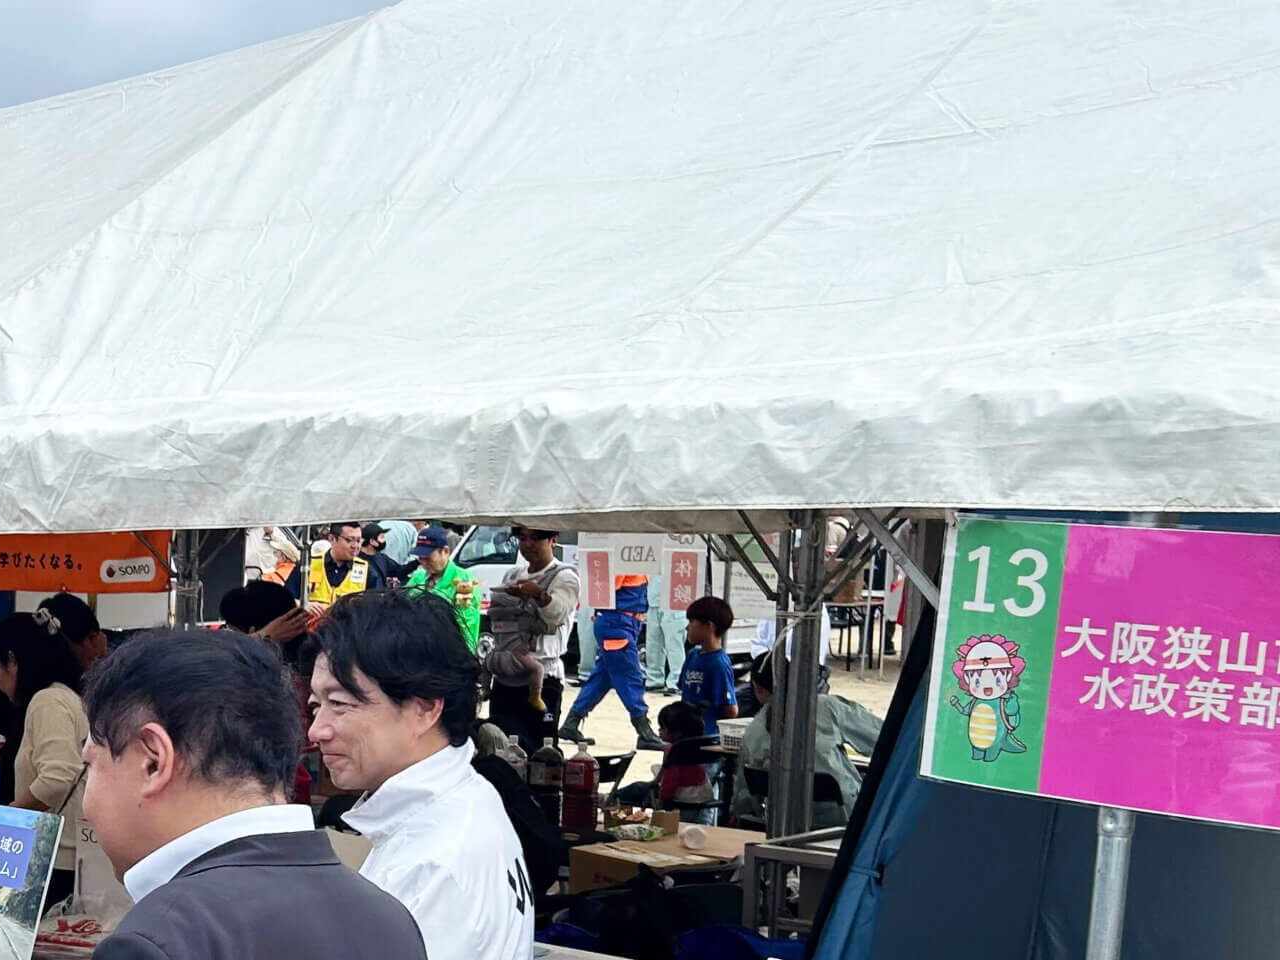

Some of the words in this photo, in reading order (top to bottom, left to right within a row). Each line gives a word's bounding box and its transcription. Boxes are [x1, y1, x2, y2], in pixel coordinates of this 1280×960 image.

[119, 564, 150, 576] SOMPO
[962, 545, 1049, 617] 13
[1061, 617, 1280, 677] 大阪狭山
[1079, 667, 1280, 731] 水政策部
